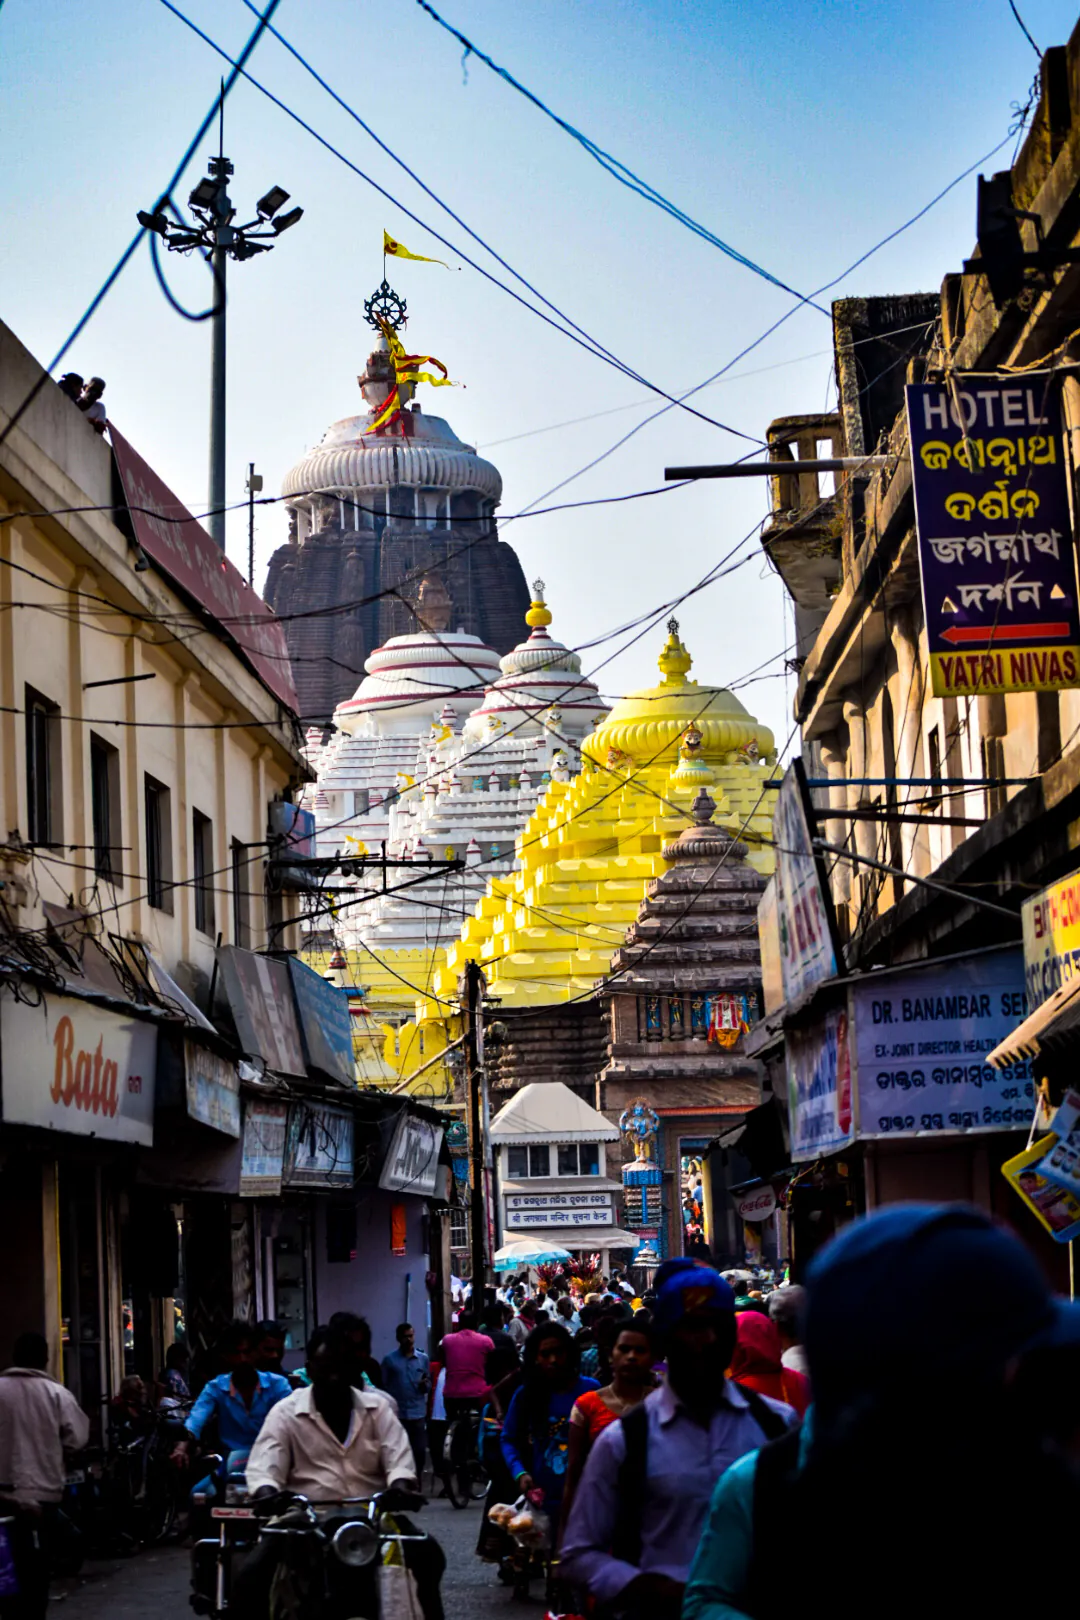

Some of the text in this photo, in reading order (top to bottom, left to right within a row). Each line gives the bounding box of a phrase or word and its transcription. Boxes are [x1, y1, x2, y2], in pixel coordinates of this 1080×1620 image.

[922, 389, 1049, 430] HOTEL
[944, 480, 1041, 522] ଦର୍ଶନ
[928, 528, 1063, 566] জগন্নাথ
[956, 570, 1043, 612] দর্শন
[938, 650, 1077, 689] YATRI NIVAS
[872, 999, 898, 1025] DR.
[902, 993, 992, 1023] BANAMBAR
[50, 1014, 119, 1118] Bata
[918, 1040, 961, 1055] DIRECTOR
